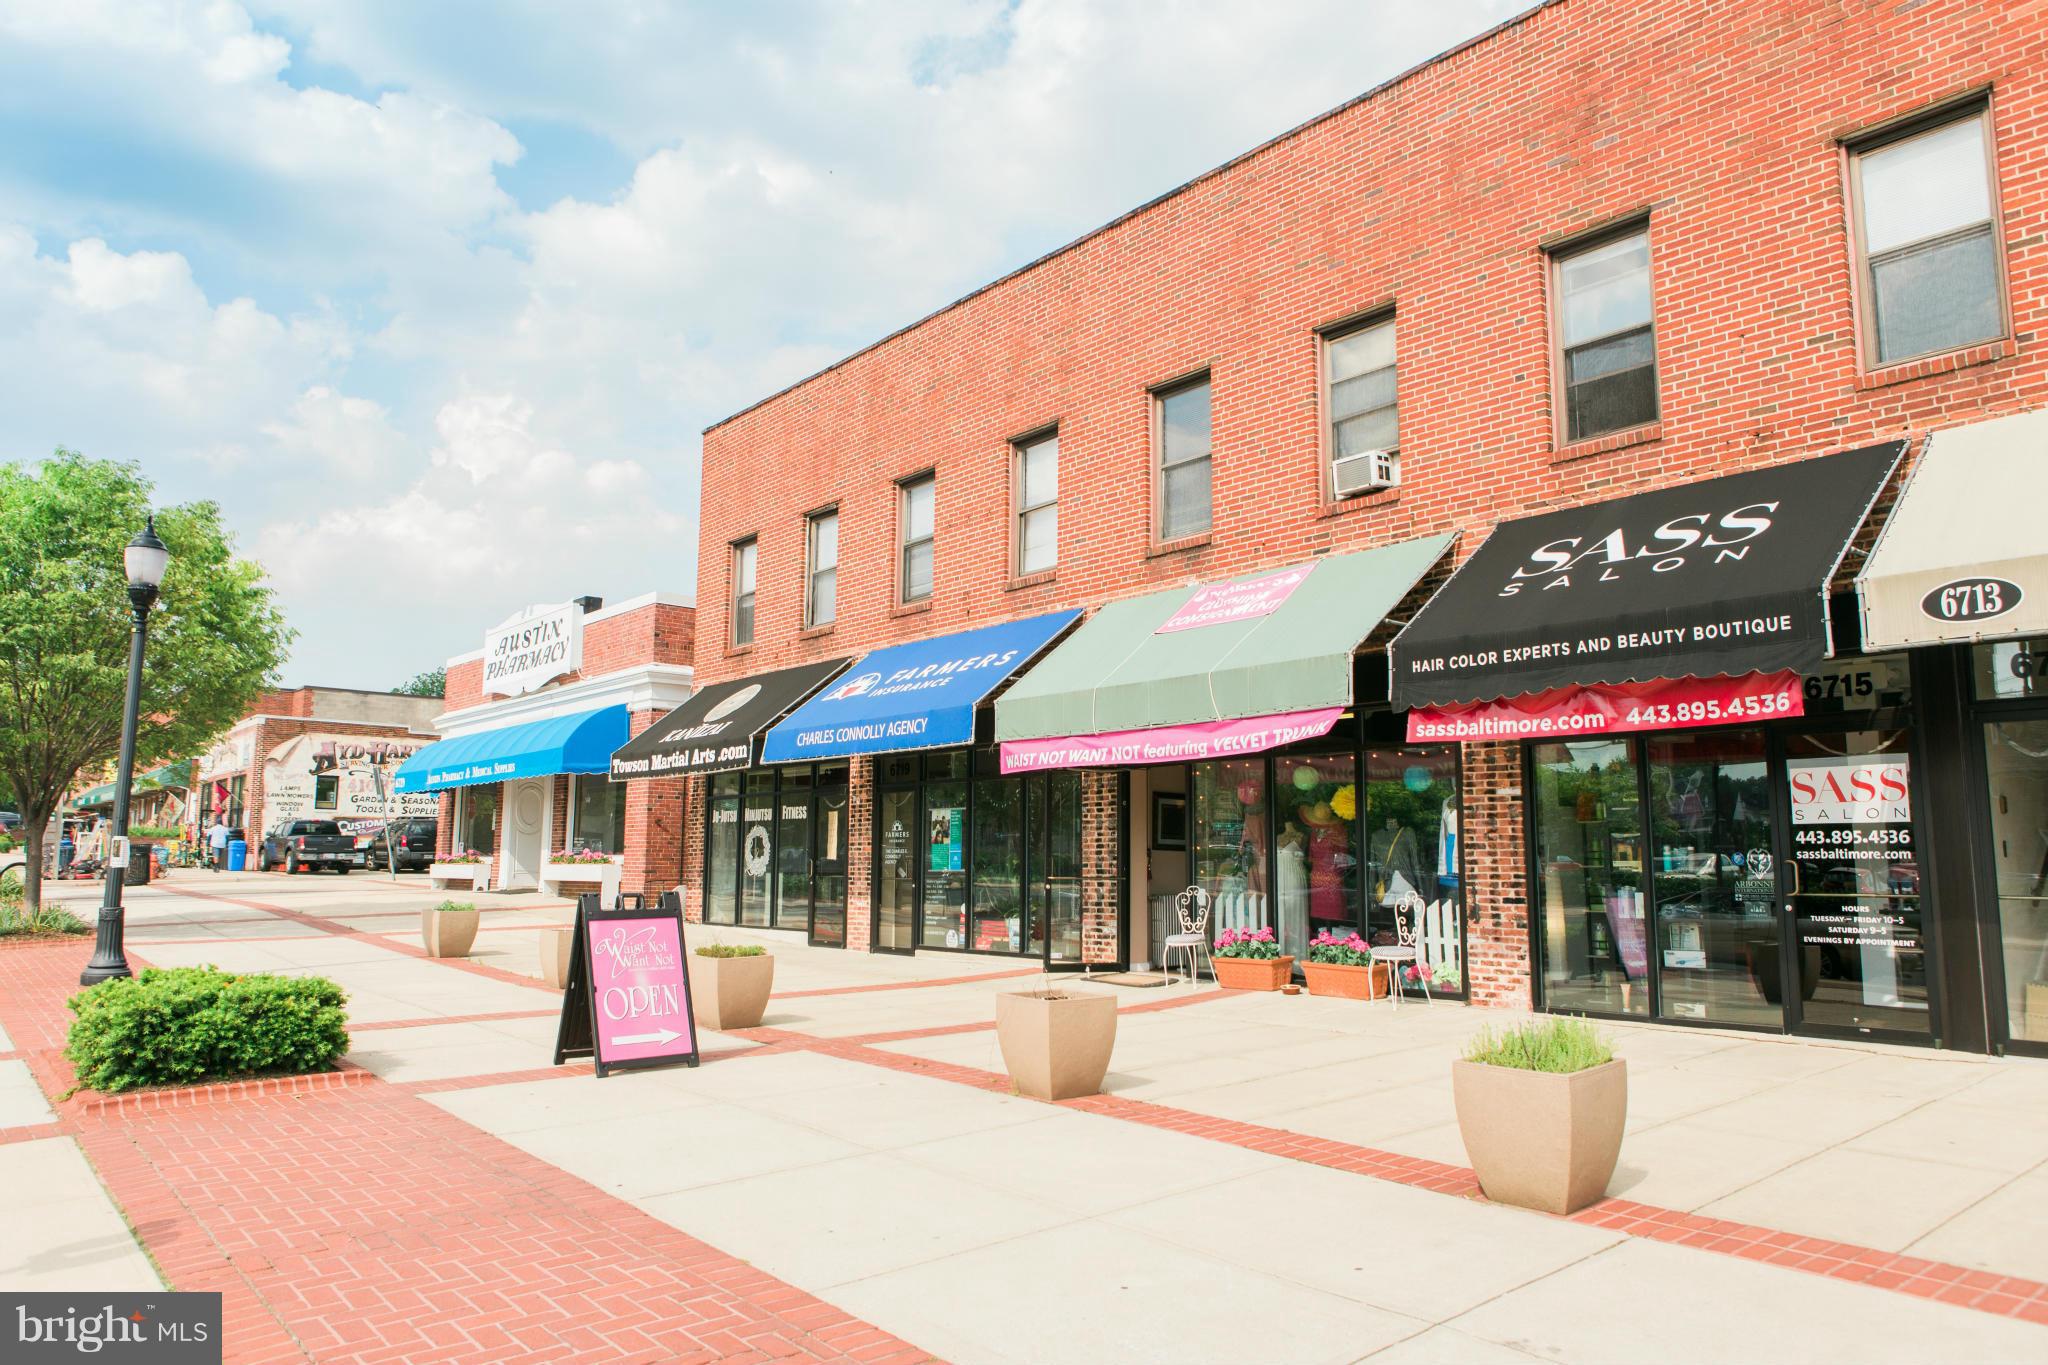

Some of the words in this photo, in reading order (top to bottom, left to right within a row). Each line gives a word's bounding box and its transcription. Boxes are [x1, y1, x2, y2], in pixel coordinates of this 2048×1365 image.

[1512, 501, 1780, 580] SASS
[1498, 545, 1750, 597] SALON
[1940, 583, 2002, 618] 6713
[495, 618, 564, 657] AUSTIN
[1411, 657, 1444, 673] HAIR
[1449, 651, 1498, 669] COLOR
[1503, 642, 1571, 663] EXPERTS
[1576, 638, 1611, 653] AND
[1617, 628, 1686, 649] BEAUTY
[1694, 615, 1792, 641] BOUTIQUE
[487, 636, 570, 680] PHARMACY
[886, 650, 1018, 685] FARMERS
[868, 676, 953, 698] INSURANCE
[1804, 672, 1873, 699] 6715
[1415, 710, 1605, 738] sassbaltimore.com
[1626, 693, 1791, 726] 443.895.4536
[797, 729, 834, 747] CHARLES
[836, 724, 886, 742] CONNOLLY
[887, 718, 929, 735] AGENCY
[1006, 753, 1035, 769] WAIST
[1038, 750, 1066, 765] NOT
[1069, 748, 1107, 764] WANT
[1112, 745, 1140, 761] NOT
[1144, 740, 1207, 760] featuring
[1213, 730, 1267, 751] VELVET
[1273, 720, 1331, 743] TRUNK
[366, 742, 421, 764] HAR
[613, 758, 649, 774] Towson
[651, 751, 689, 770] Martial
[691, 748, 716, 764] Arts
[718, 744, 747, 762] .com
[442, 771, 464, 782] PHARMACY
[465, 768, 470, 778] &
[1792, 767, 1907, 805] SASS
[356, 805, 383, 813] TOOLS
[782, 805, 807, 820] FITNESS
[1795, 808, 1907, 821] SALON
[1795, 829, 1911, 845] 443.895.4536
[1796, 849, 1912, 860] sassbaltimore.com
[1803, 936, 1842, 944] EVENINGS
[1856, 938, 1915, 947] APPOINTMENT
[1828, 926, 1867, 934] SATURDAY
[624, 954, 648, 967] Want
[656, 955, 674, 966] Not
[649, 942, 667, 952] Not
[604, 984, 679, 1020] OPEN
